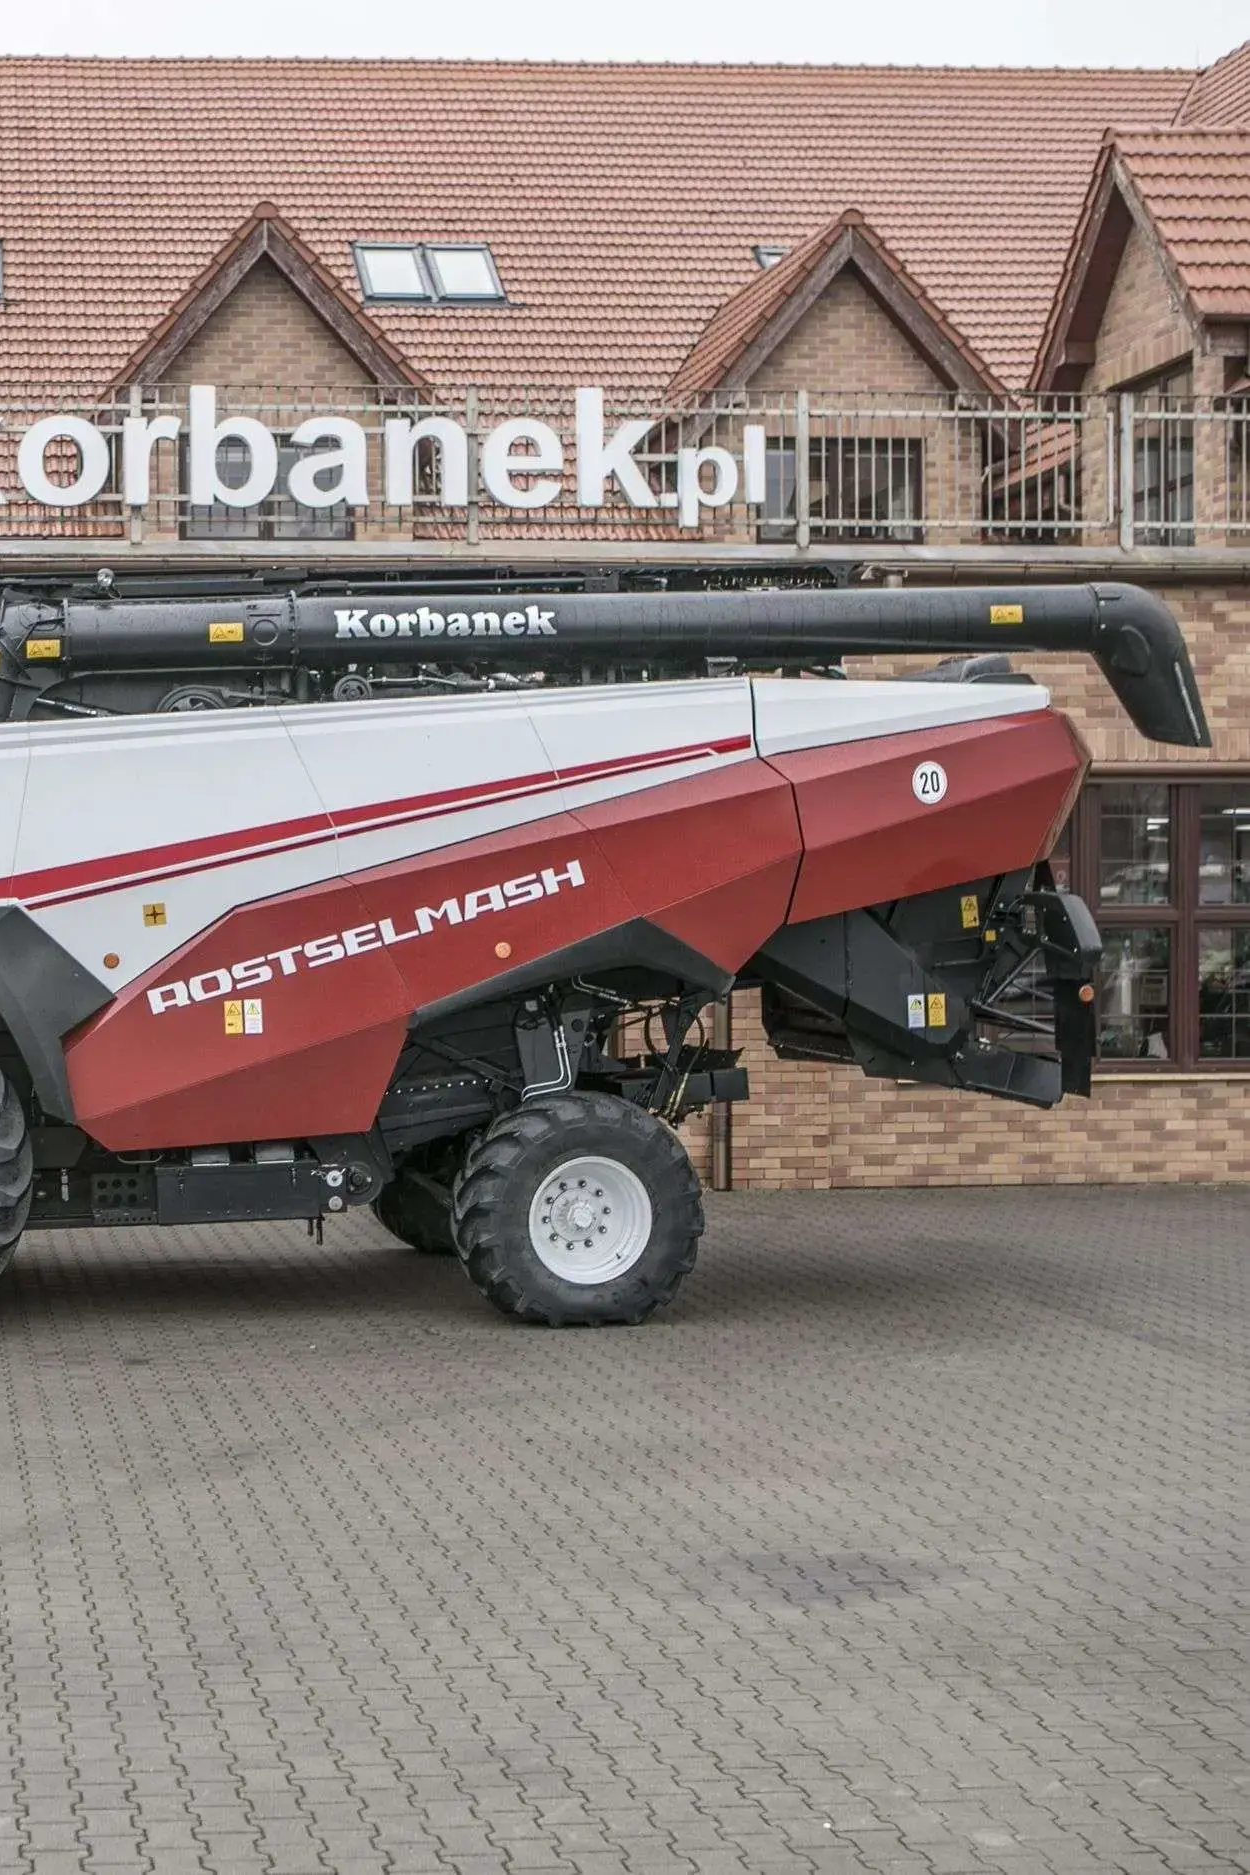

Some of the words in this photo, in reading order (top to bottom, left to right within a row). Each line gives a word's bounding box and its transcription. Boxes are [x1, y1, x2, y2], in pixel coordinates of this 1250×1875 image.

[333, 605, 558, 638] Korbanek
[920, 771, 940, 794] 20
[147, 859, 586, 1016] ROSTSELMASH
